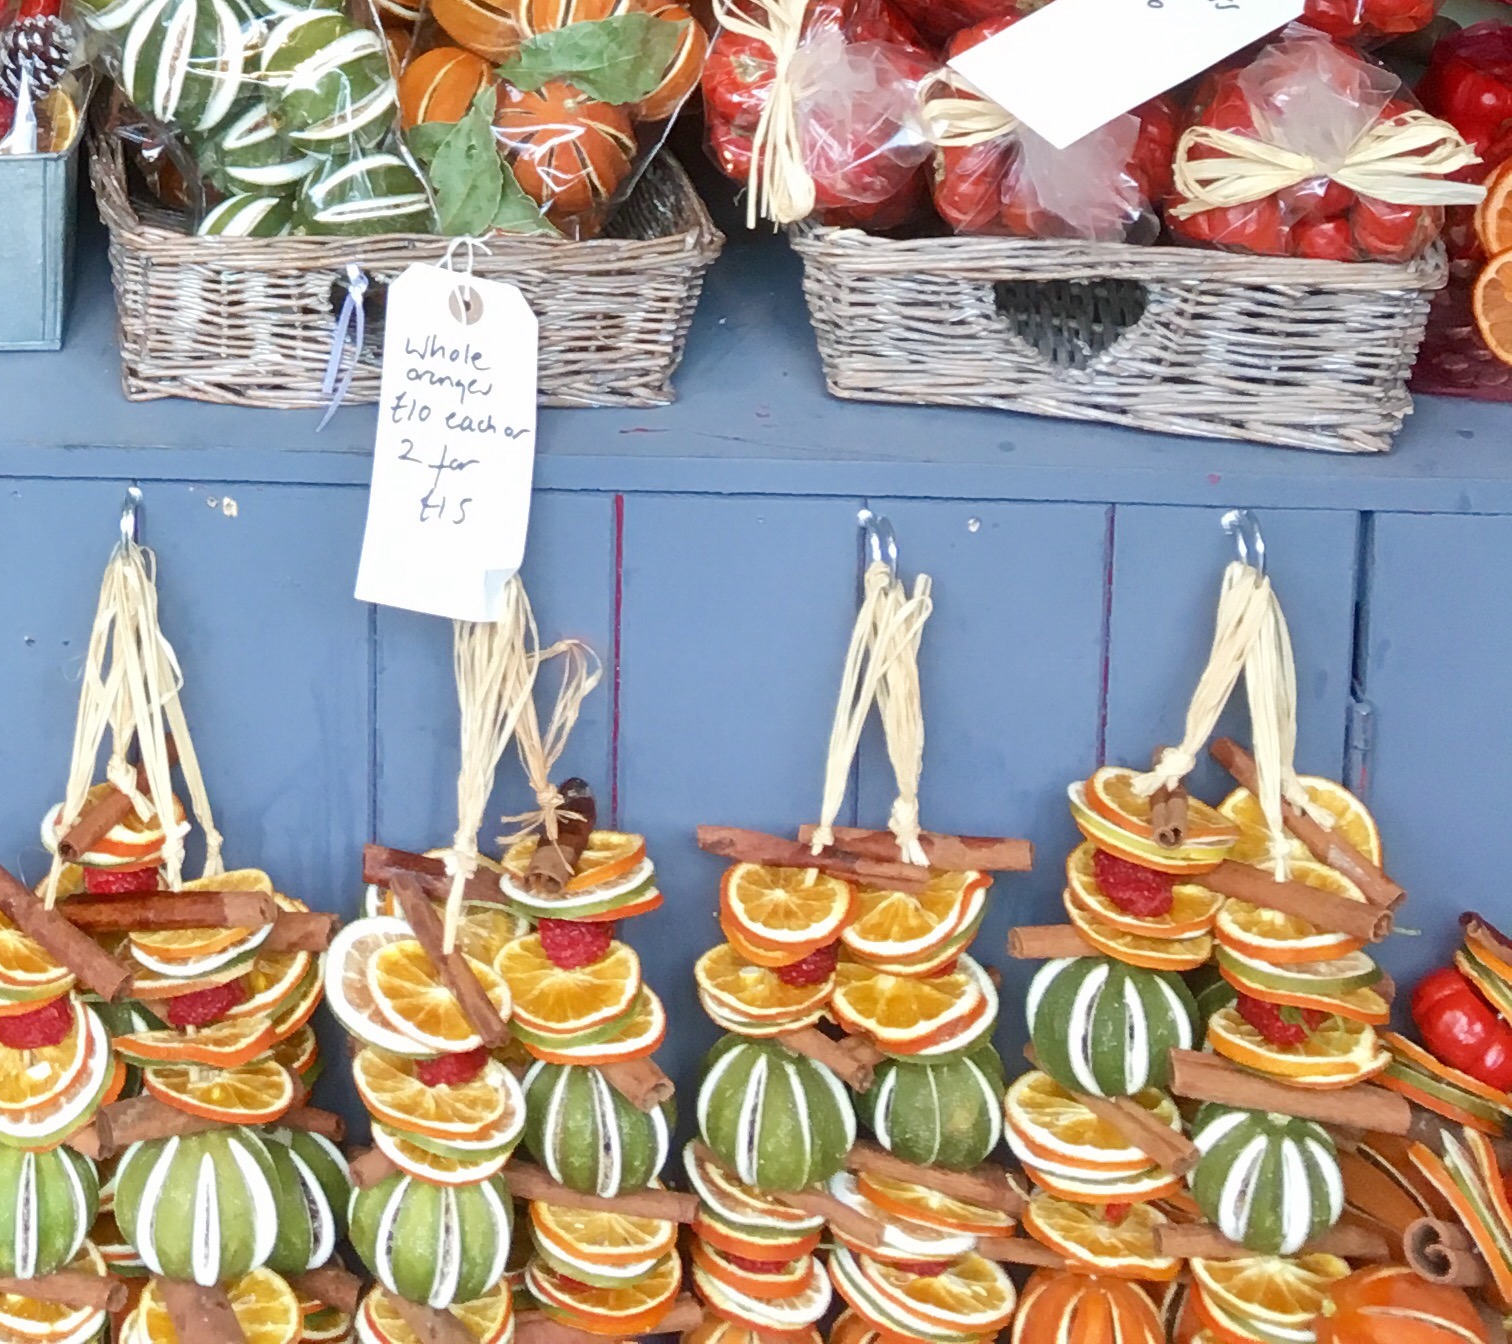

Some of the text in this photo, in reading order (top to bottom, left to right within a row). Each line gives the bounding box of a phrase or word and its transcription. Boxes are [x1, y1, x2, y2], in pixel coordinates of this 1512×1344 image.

[405, 334, 492, 371] Whole
[390, 391, 532, 440] £10 each or
[396, 438, 481, 491] 2 for
[419, 488, 473, 525] £15
